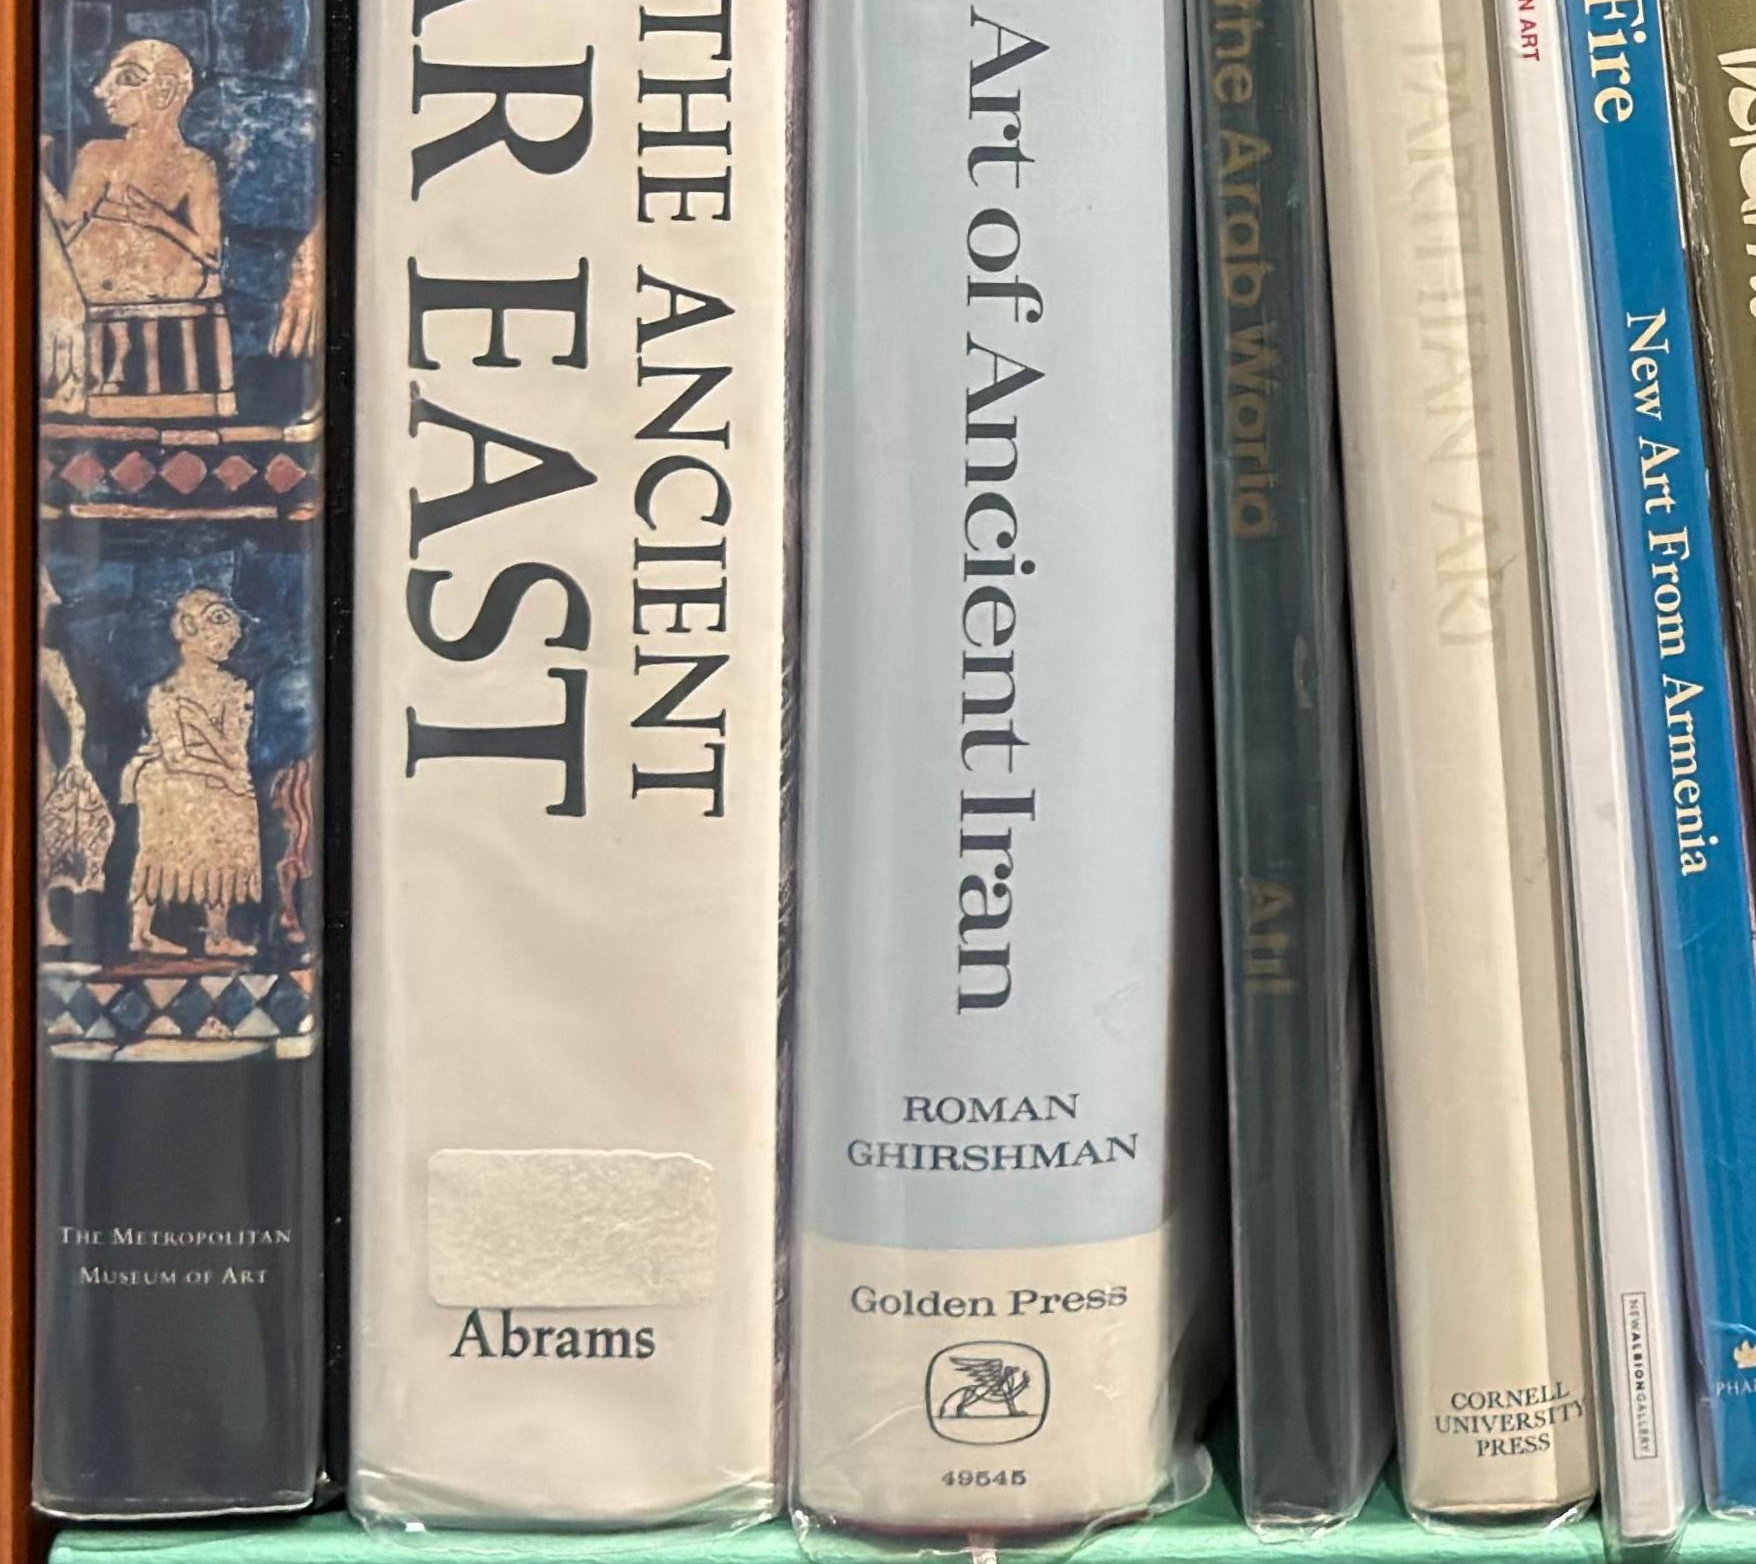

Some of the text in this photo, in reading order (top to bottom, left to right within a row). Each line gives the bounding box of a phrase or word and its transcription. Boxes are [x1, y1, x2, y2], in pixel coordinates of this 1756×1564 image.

[1518, 18, 1540, 63] ART
[966, 3, 1051, 190] Art
[1218, 130, 1275, 307] Arab
[965, 207, 1044, 324] of
[1226, 320, 1283, 537] World
[405, 255, 598, 819] EAST
[629, 262, 735, 818] ANCIENT
[960, 331, 1047, 774] Ancient
[1625, 307, 1719, 877] New Art From Armenia
[957, 788, 1037, 1016] Iran
[902, 1092, 1080, 1125] ROMAN
[846, 1133, 1140, 1172] GHIRSHMAN
[449, 1308, 656, 1360] Abrams
[850, 1284, 1128, 1318] Golden Press
[1434, 1398, 1586, 1435] UNIVERSITY
[1450, 1381, 1571, 1412] CORNELL
[941, 1469, 1027, 1487] 49545
[1476, 1432, 1551, 1458] PRESS
